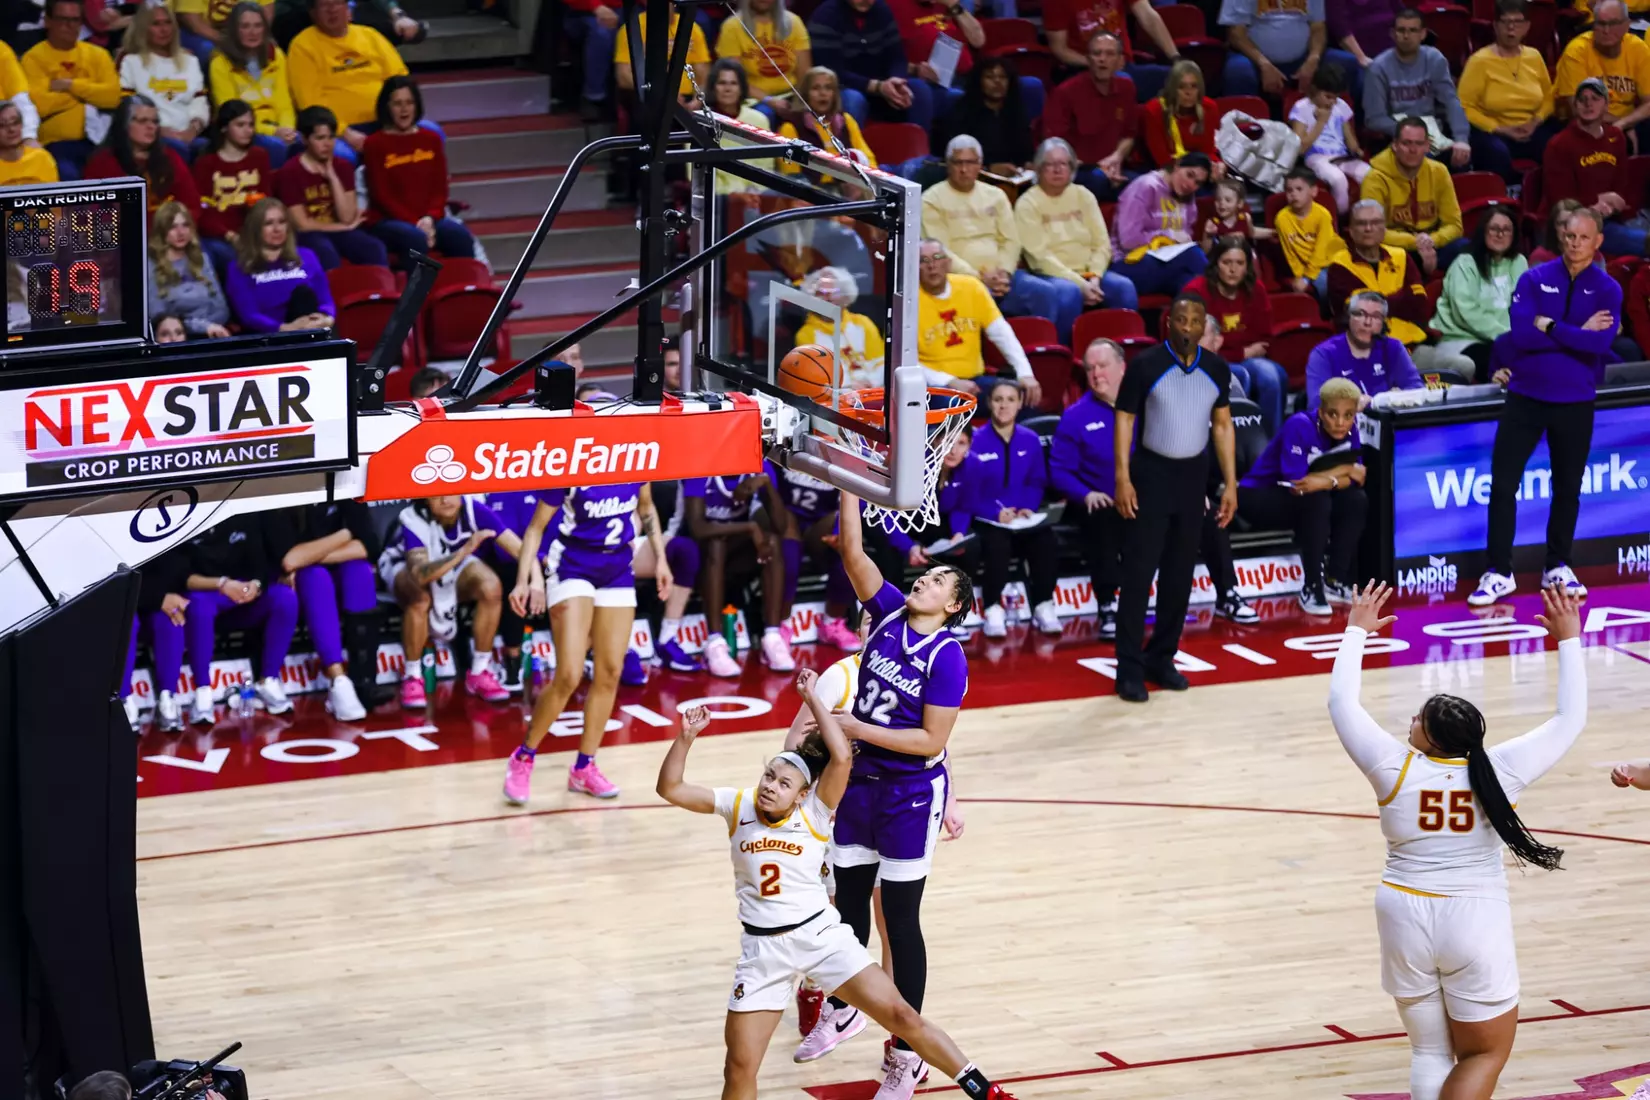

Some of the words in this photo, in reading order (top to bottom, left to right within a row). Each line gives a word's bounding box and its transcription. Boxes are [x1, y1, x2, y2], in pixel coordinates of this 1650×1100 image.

[14, 191, 117, 208] DAKTRONICS
[51, 261, 100, 313] 19
[24, 375, 315, 451] NEXSTAR
[63, 459, 120, 480] CROP
[127, 443, 279, 474] PERFORMANCE
[604, 517, 624, 546] 2
[1618, 547, 1650, 564] LAN
[1397, 564, 1457, 587] LANDUS
[867, 649, 922, 698] Wildcats
[858, 678, 899, 725] 32
[1418, 789, 1475, 833] 55
[740, 836, 804, 857] Cyclones
[760, 863, 781, 897] 2
